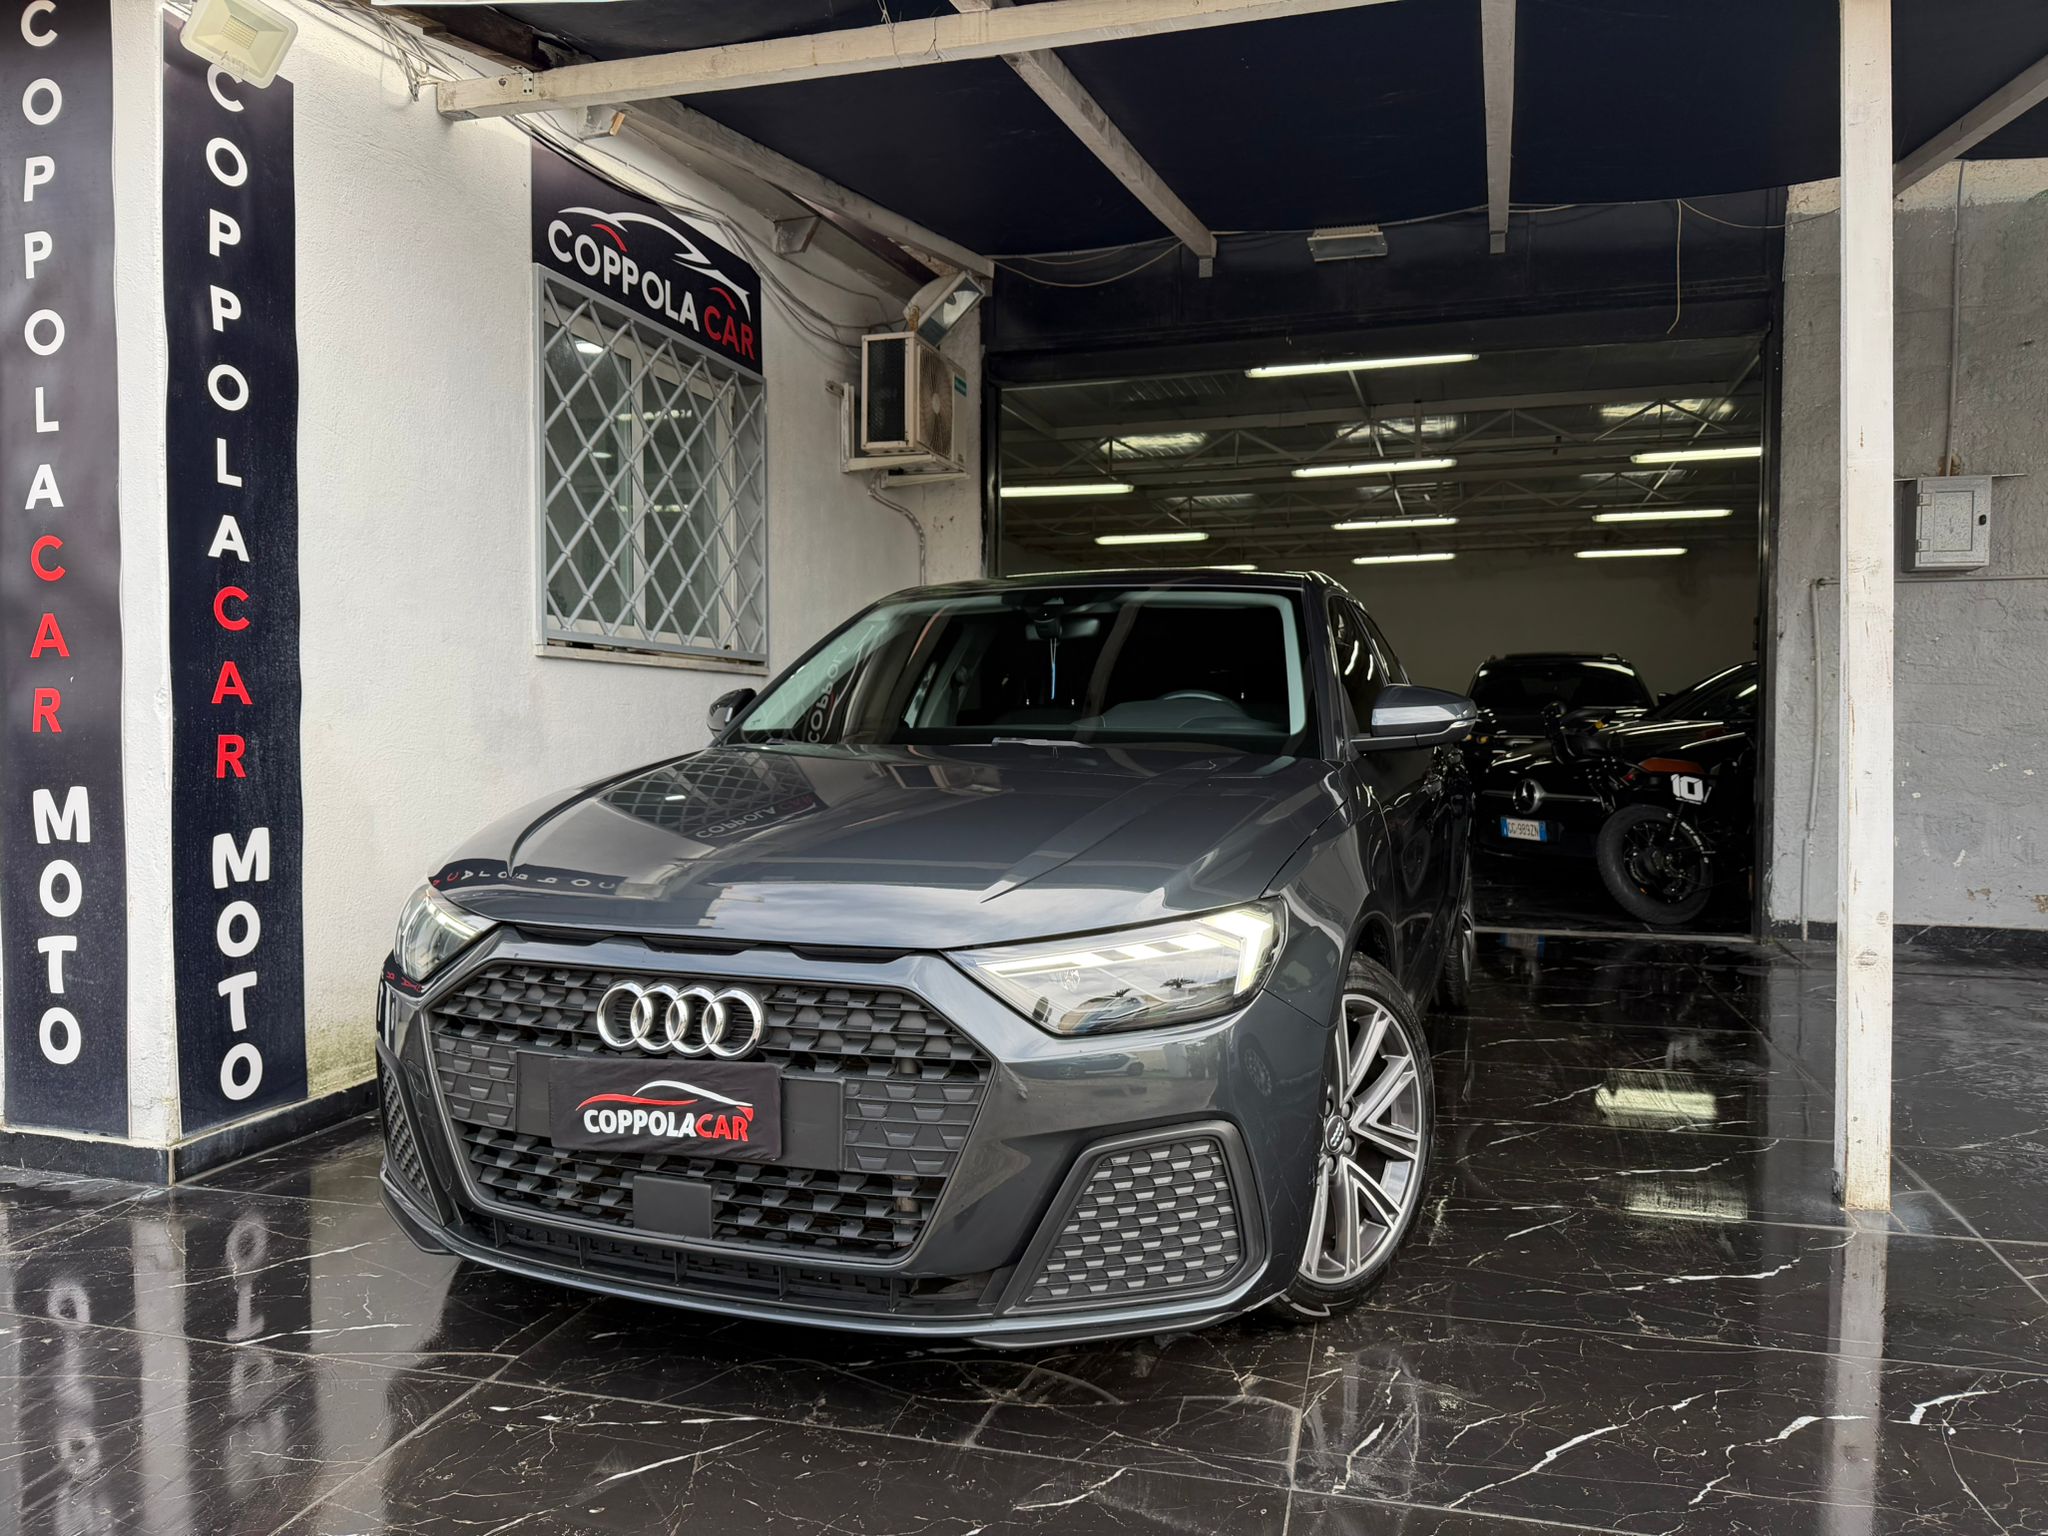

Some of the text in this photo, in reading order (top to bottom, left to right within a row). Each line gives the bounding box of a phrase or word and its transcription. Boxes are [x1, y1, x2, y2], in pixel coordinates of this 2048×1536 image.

[32, 785, 91, 1065] MOTO
[1670, 773, 1705, 802] 10
[212, 826, 271, 1101] MOTO
